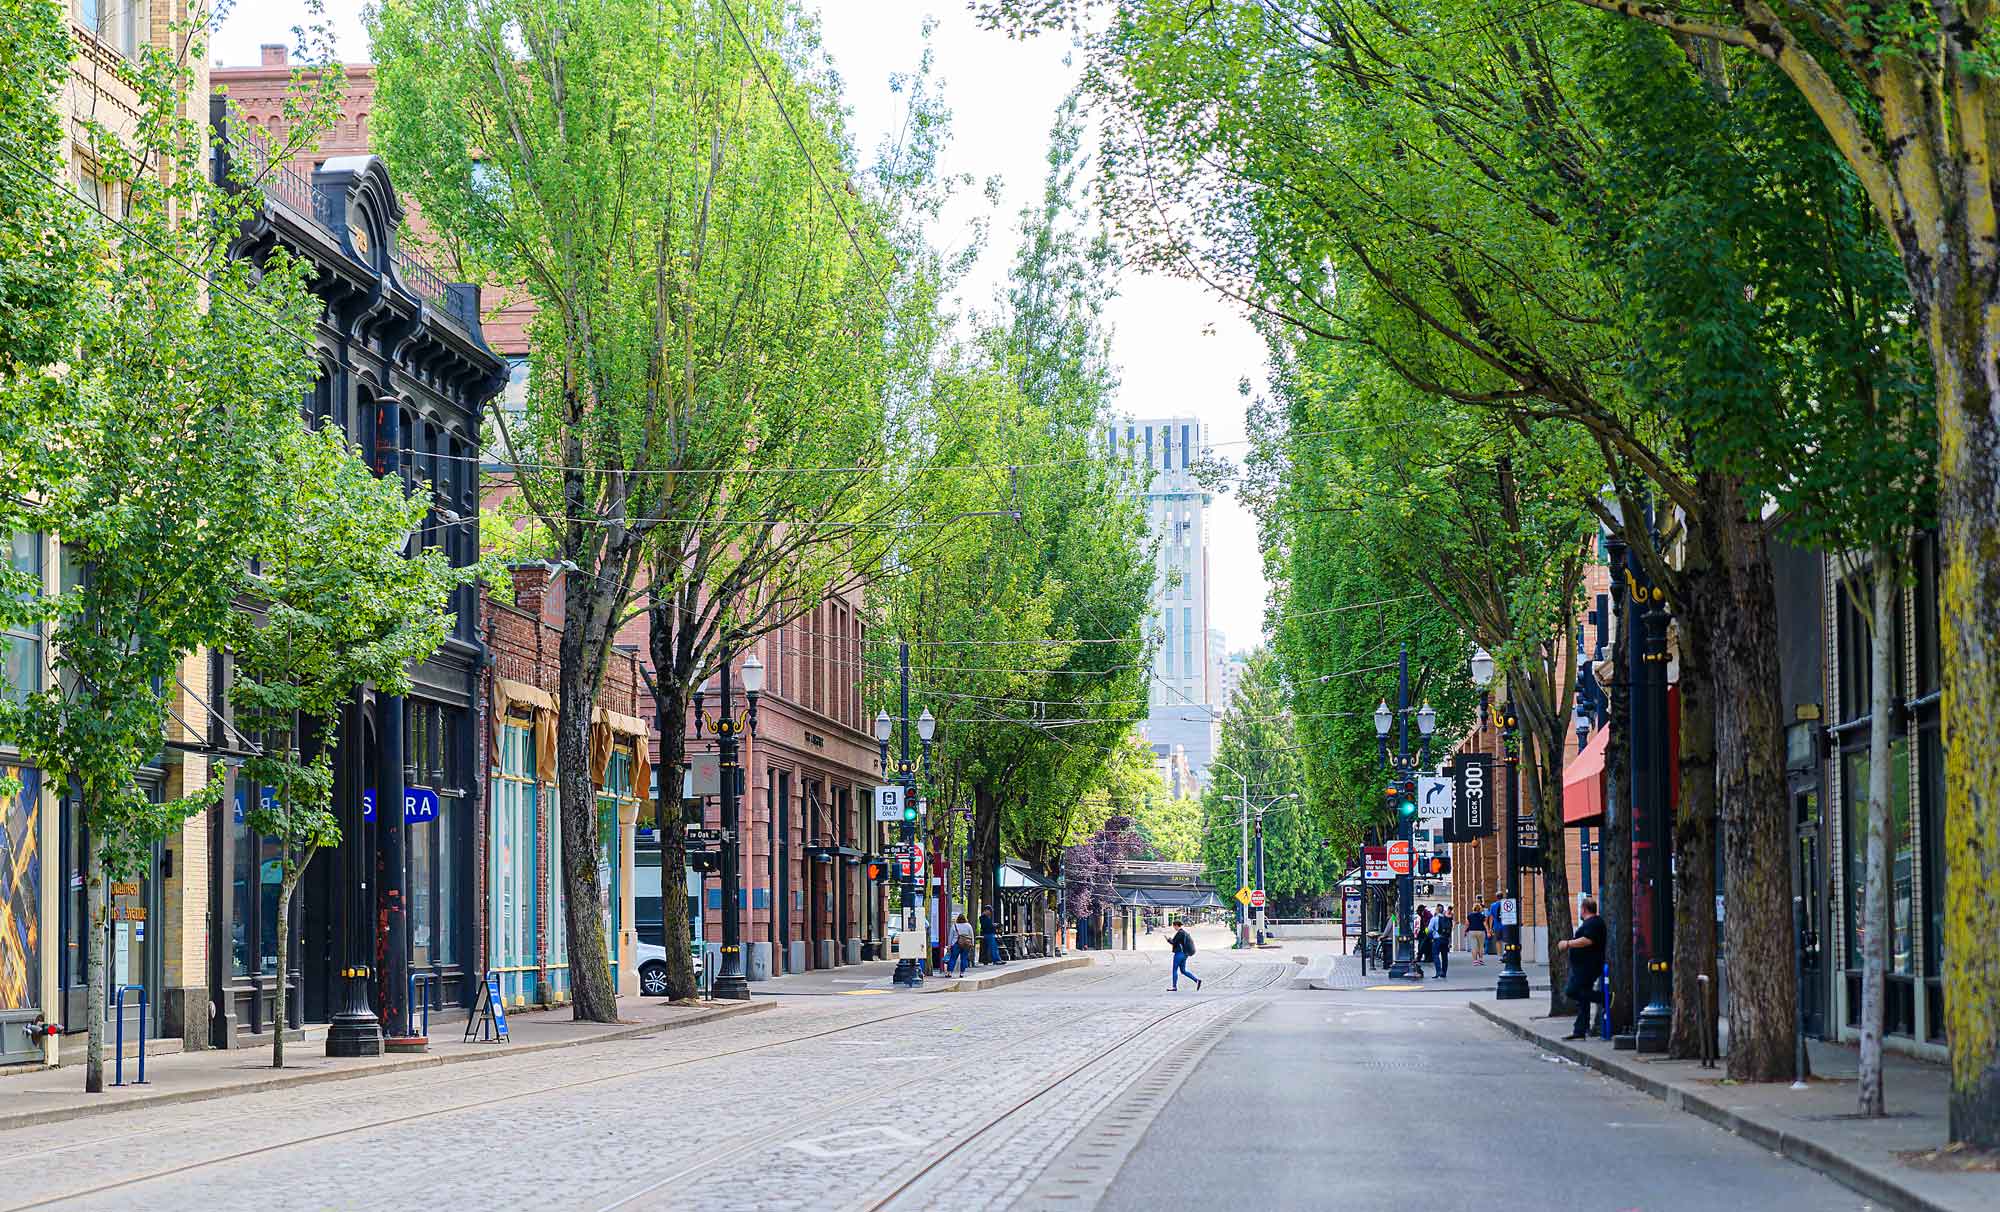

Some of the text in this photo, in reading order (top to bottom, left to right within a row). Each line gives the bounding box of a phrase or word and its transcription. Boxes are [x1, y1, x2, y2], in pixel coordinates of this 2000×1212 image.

[1465, 767, 1483, 799] 300
[1420, 806, 1449, 815] ONLY
[697, 831, 709, 839] Oak
